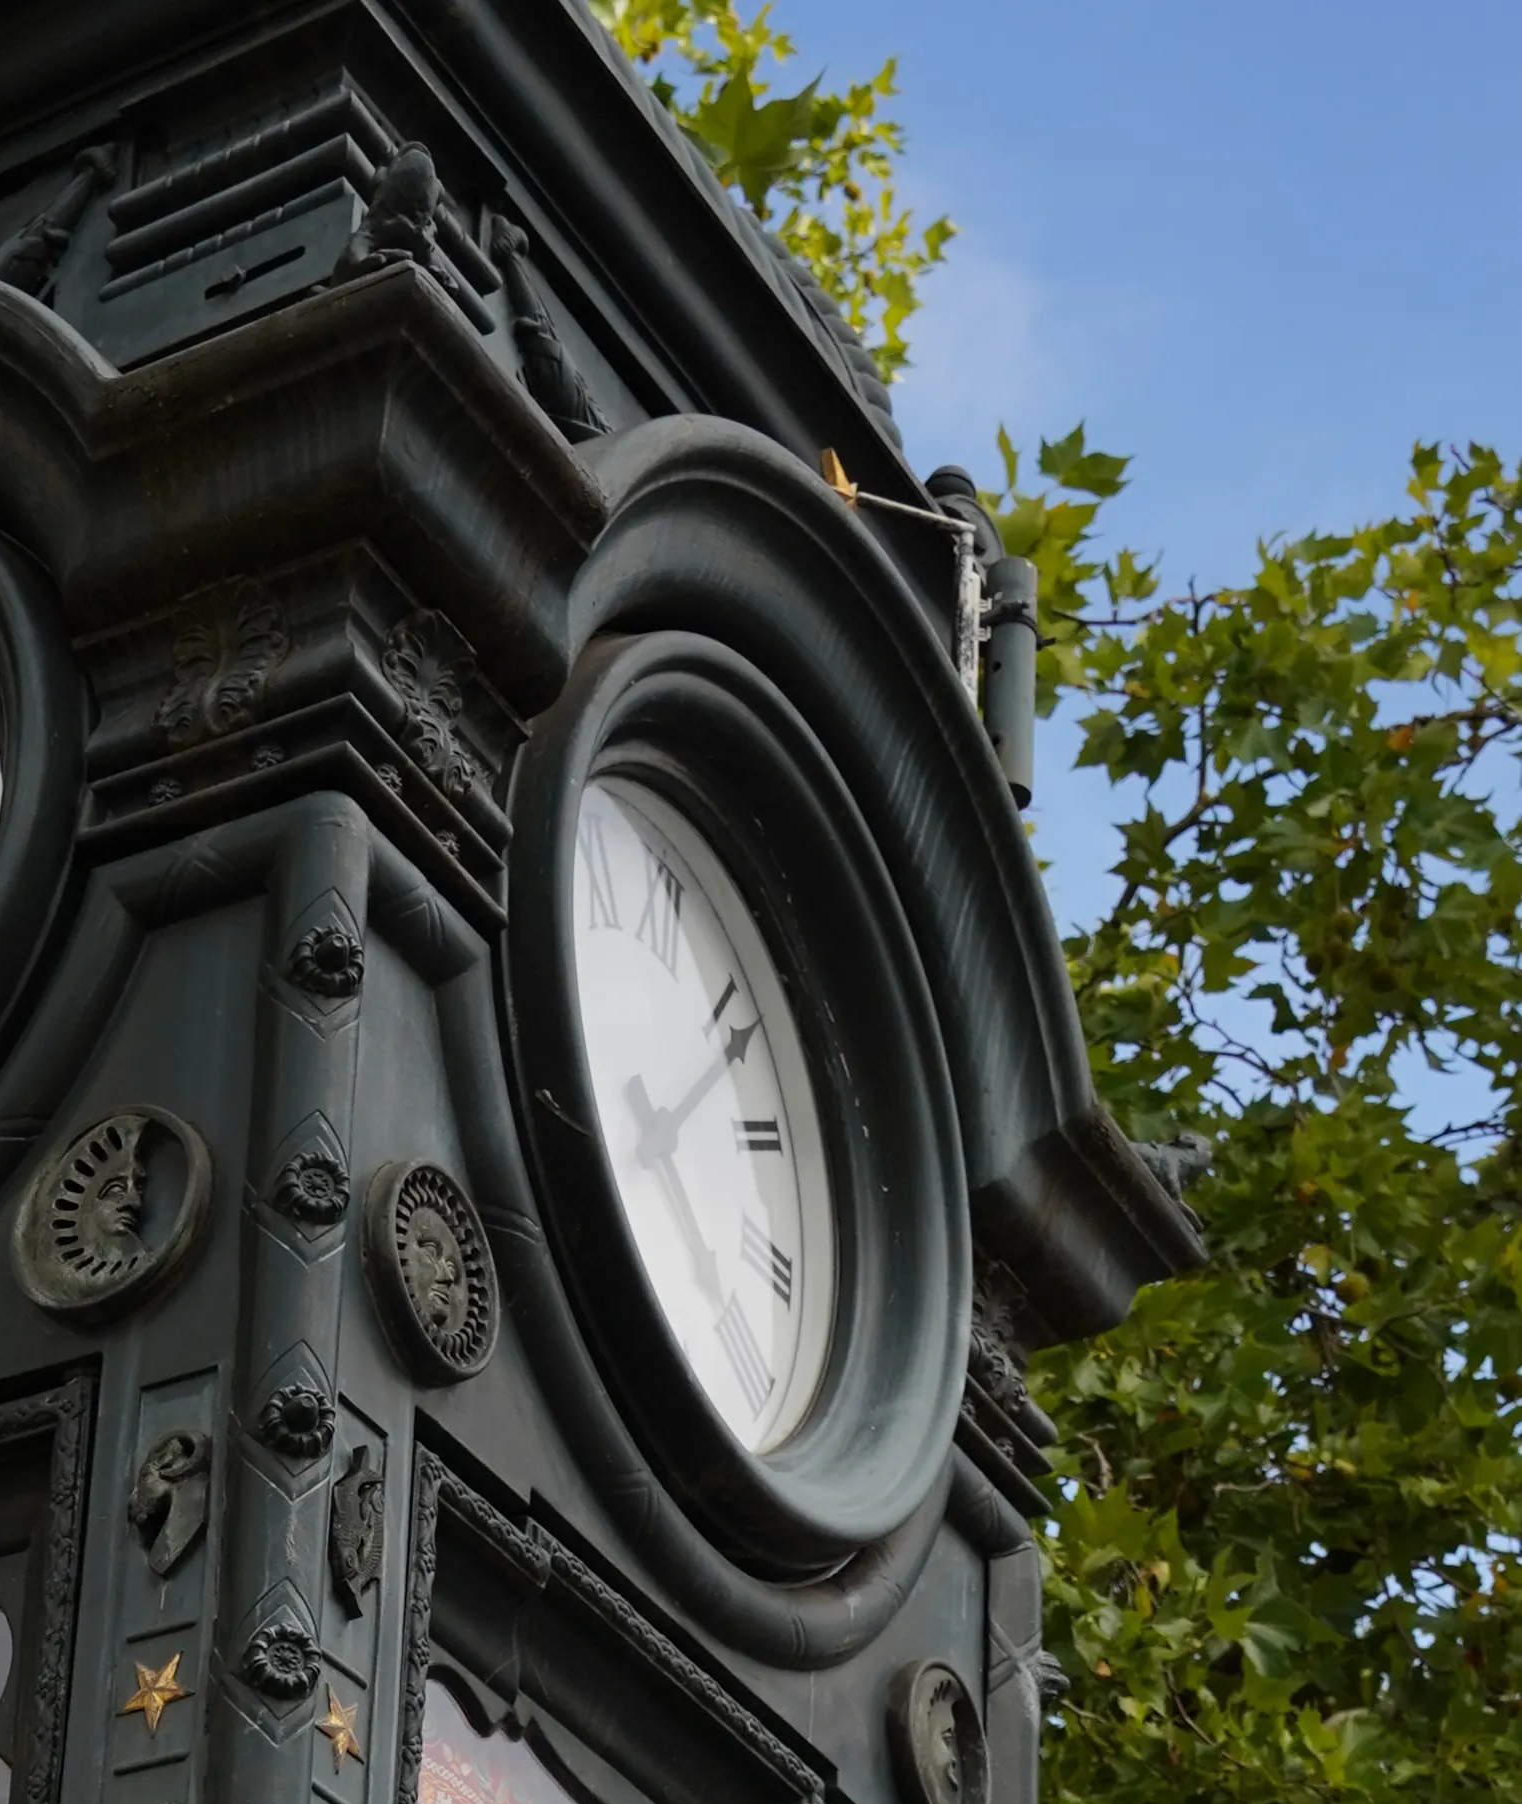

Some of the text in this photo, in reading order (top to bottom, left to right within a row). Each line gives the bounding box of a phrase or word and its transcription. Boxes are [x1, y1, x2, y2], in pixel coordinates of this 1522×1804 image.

[635, 842, 685, 983] XII
[731, 1116, 784, 1158] II
[740, 1207, 793, 1313] III
[714, 1289, 776, 1422] IIII
